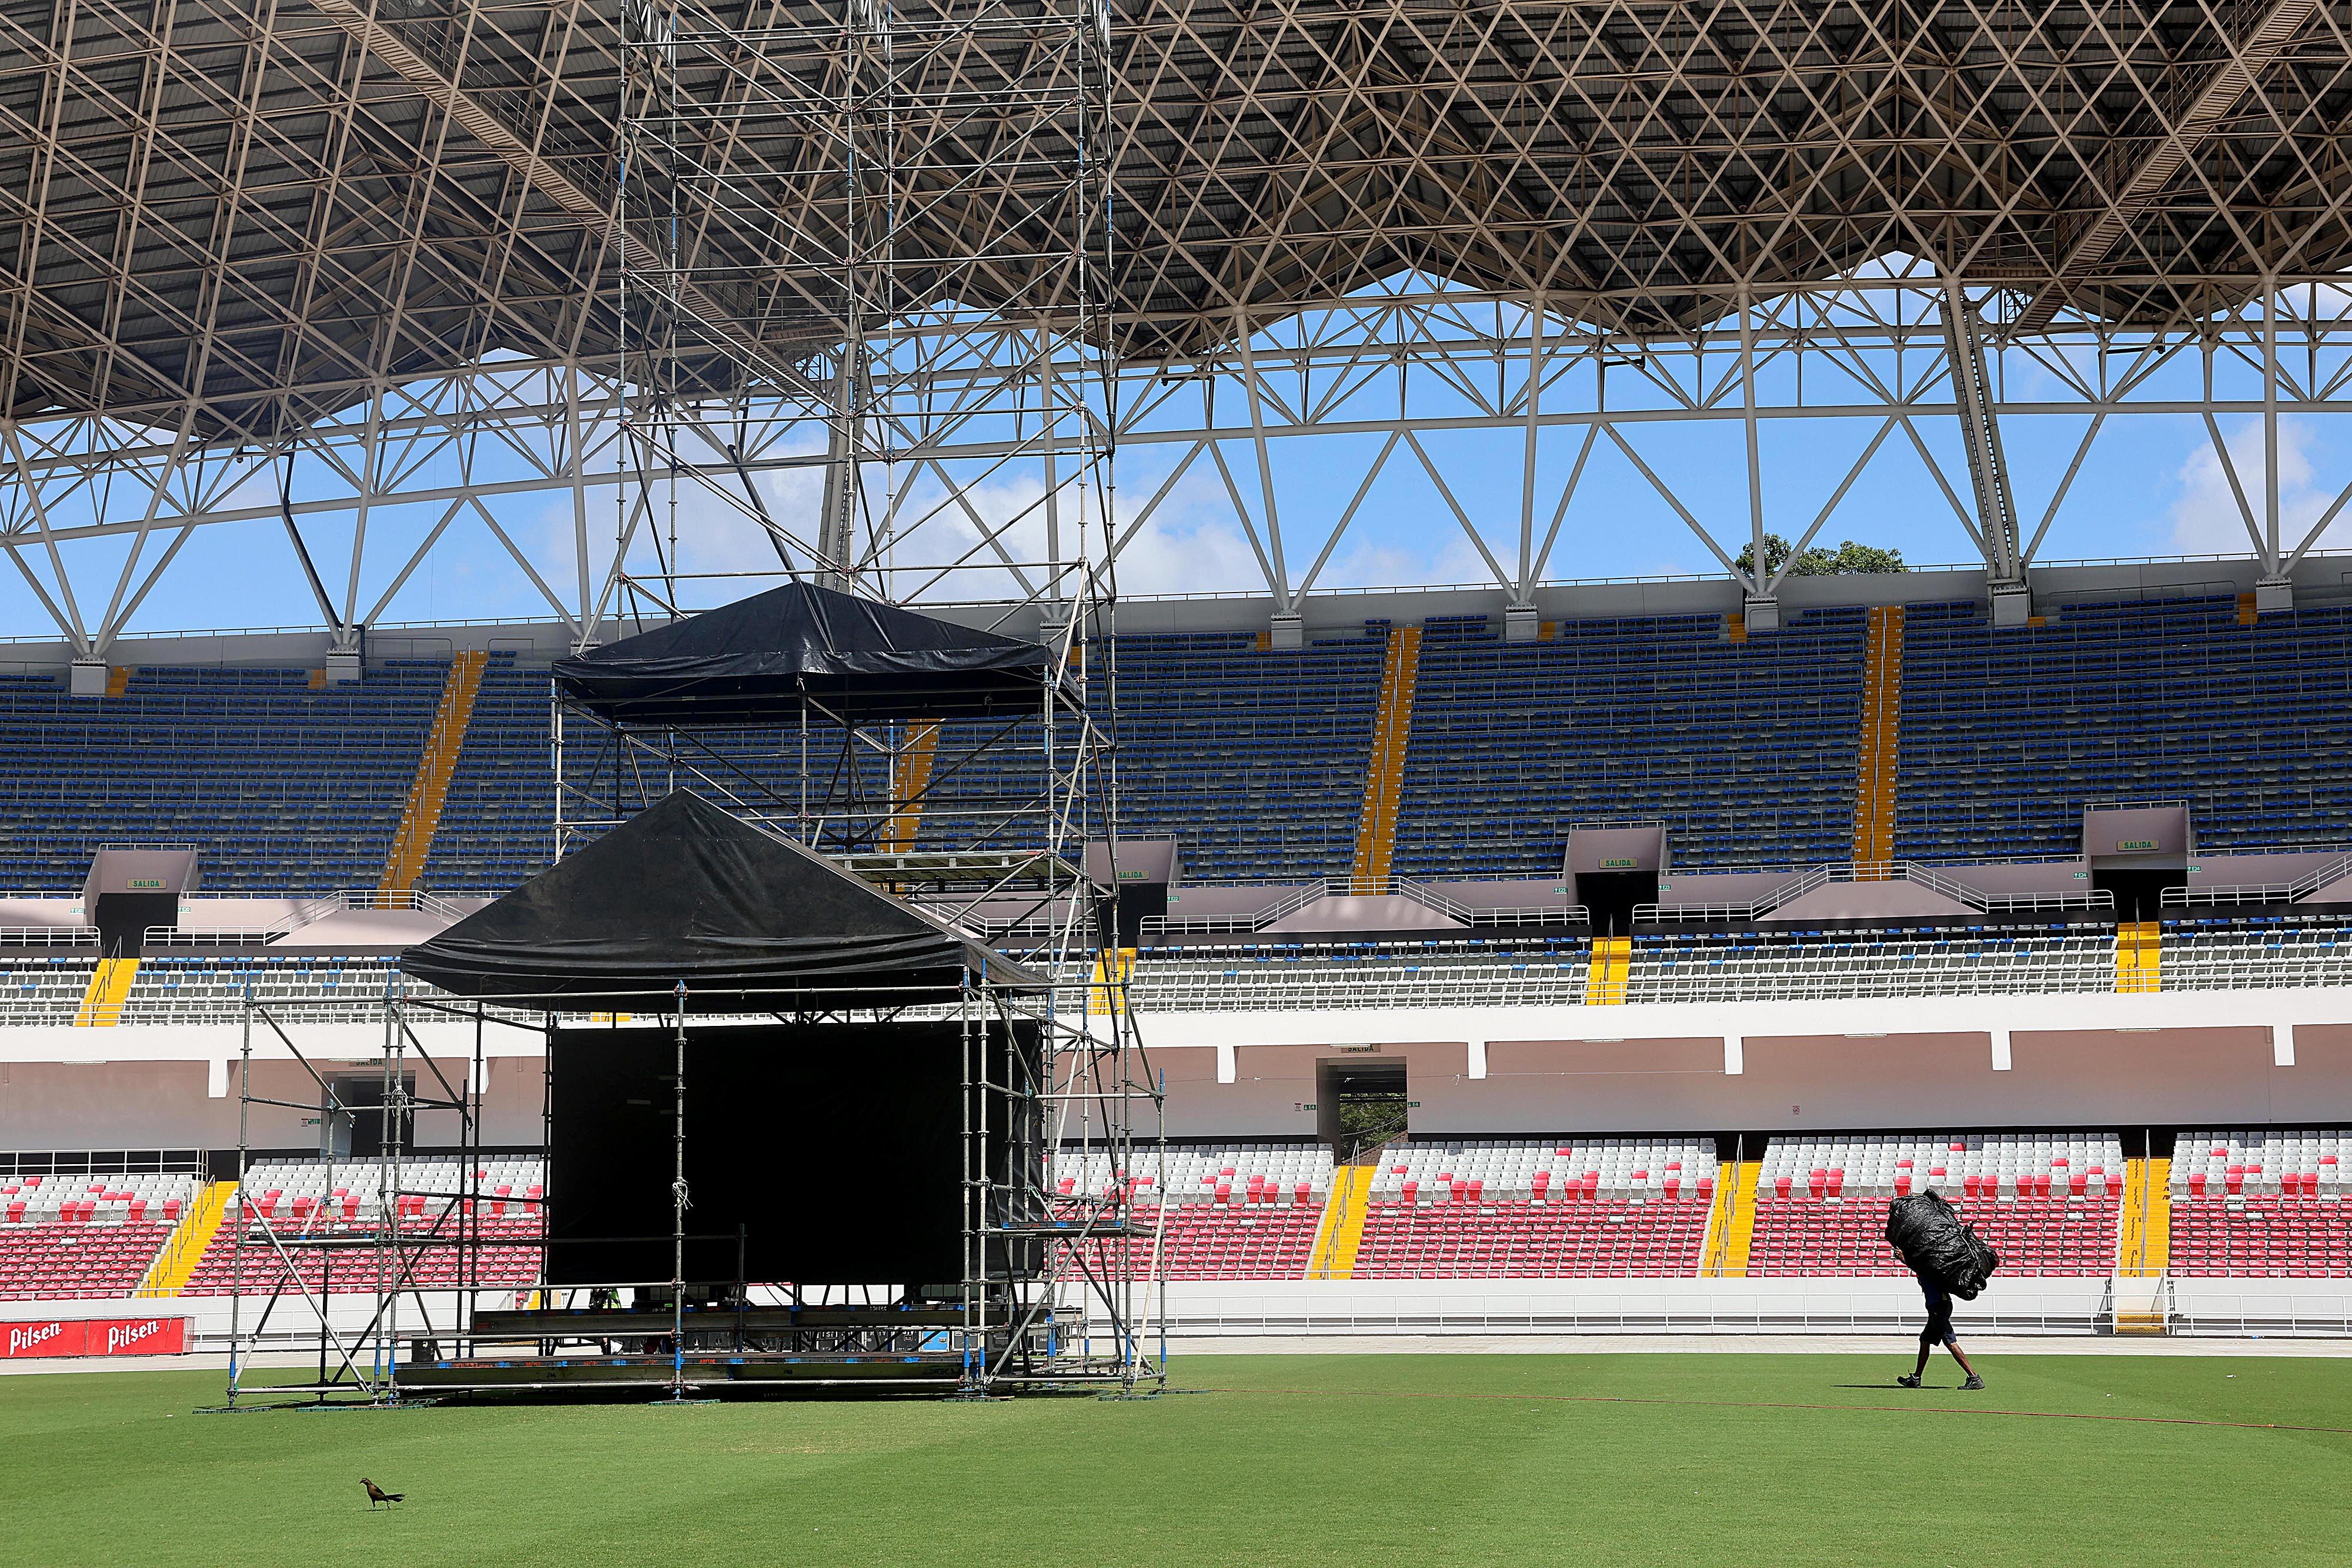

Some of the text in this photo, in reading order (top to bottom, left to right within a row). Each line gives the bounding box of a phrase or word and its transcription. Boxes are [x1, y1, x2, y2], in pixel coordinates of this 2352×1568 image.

[2124, 841, 2152, 849] SALIDA
[9, 1322, 62, 1356] Pilsen
[108, 1320, 160, 1355] Pilsen
